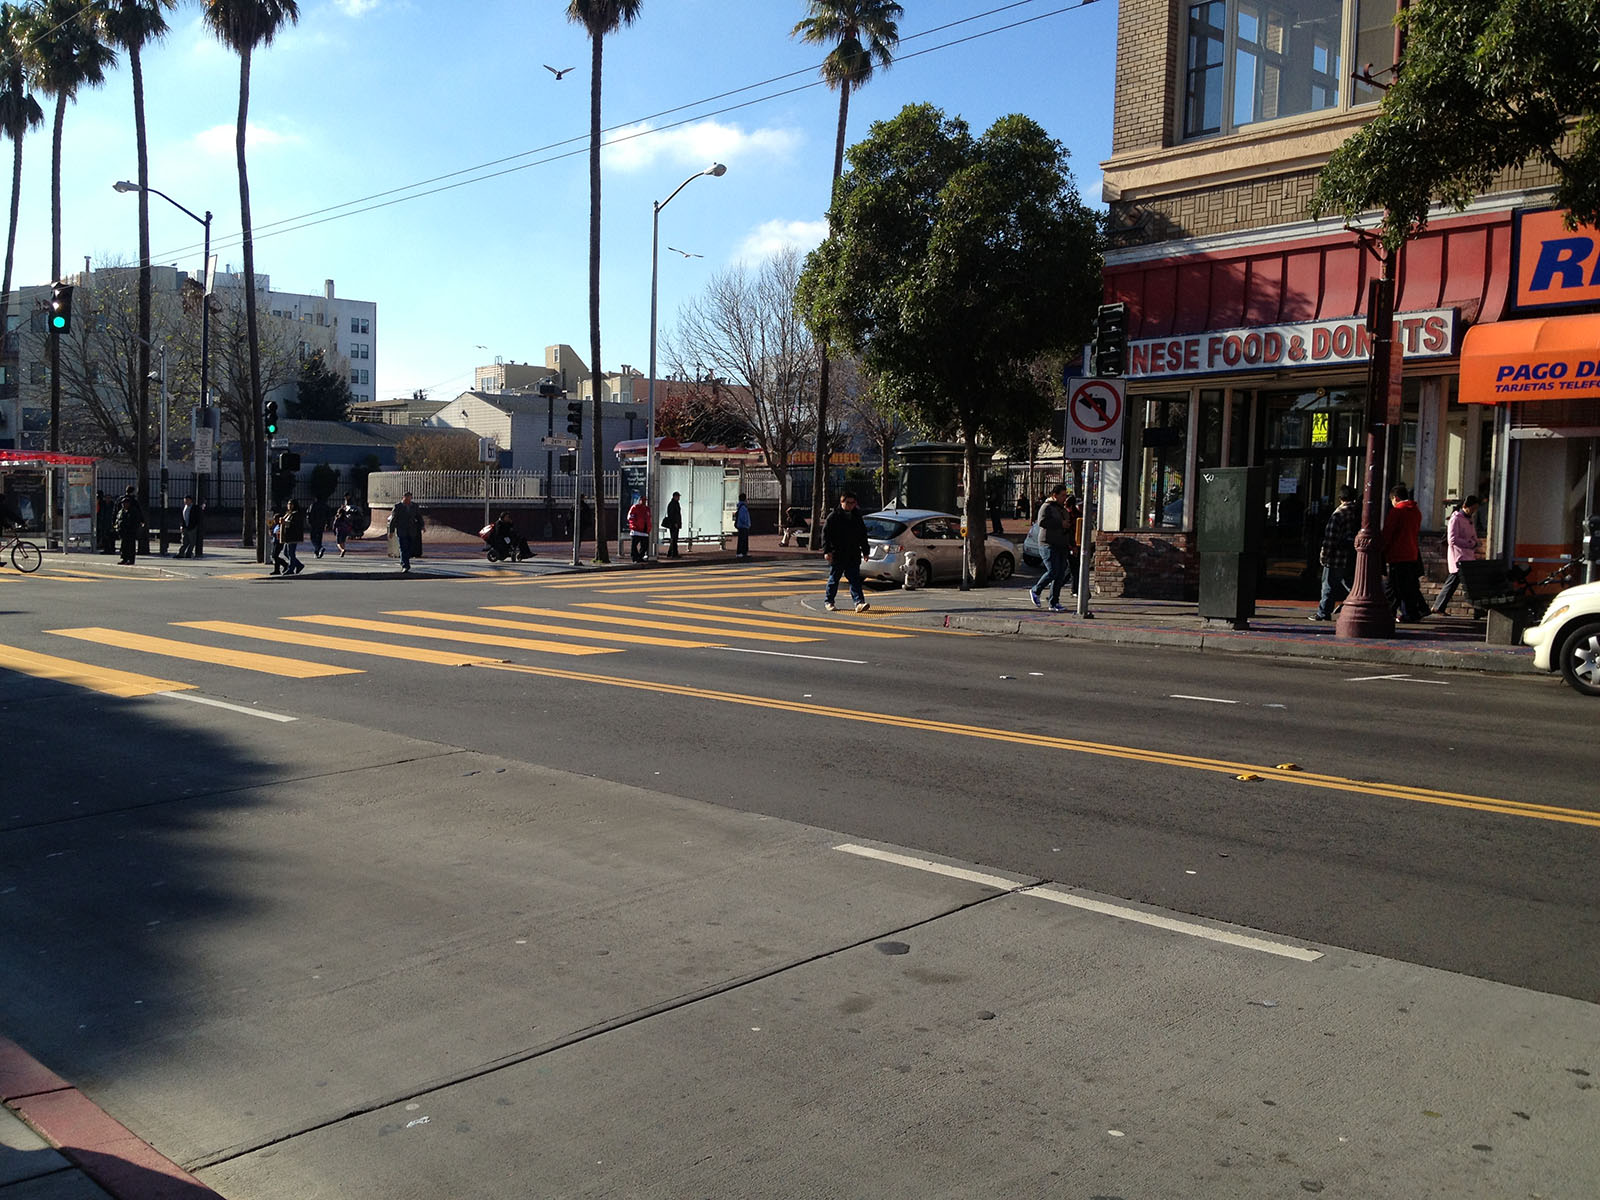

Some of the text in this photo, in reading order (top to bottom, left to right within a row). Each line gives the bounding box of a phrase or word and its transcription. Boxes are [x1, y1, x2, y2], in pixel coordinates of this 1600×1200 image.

[1529, 236, 1600, 292] R
[1125, 315, 1448, 375] INESE FOOD & DONTS
[1496, 362, 1568, 382] PAGO
[1495, 382, 1555, 393] TARJETAS
[1071, 436, 1087, 446] 11AM
[1101, 436, 1116, 446] 7PM
